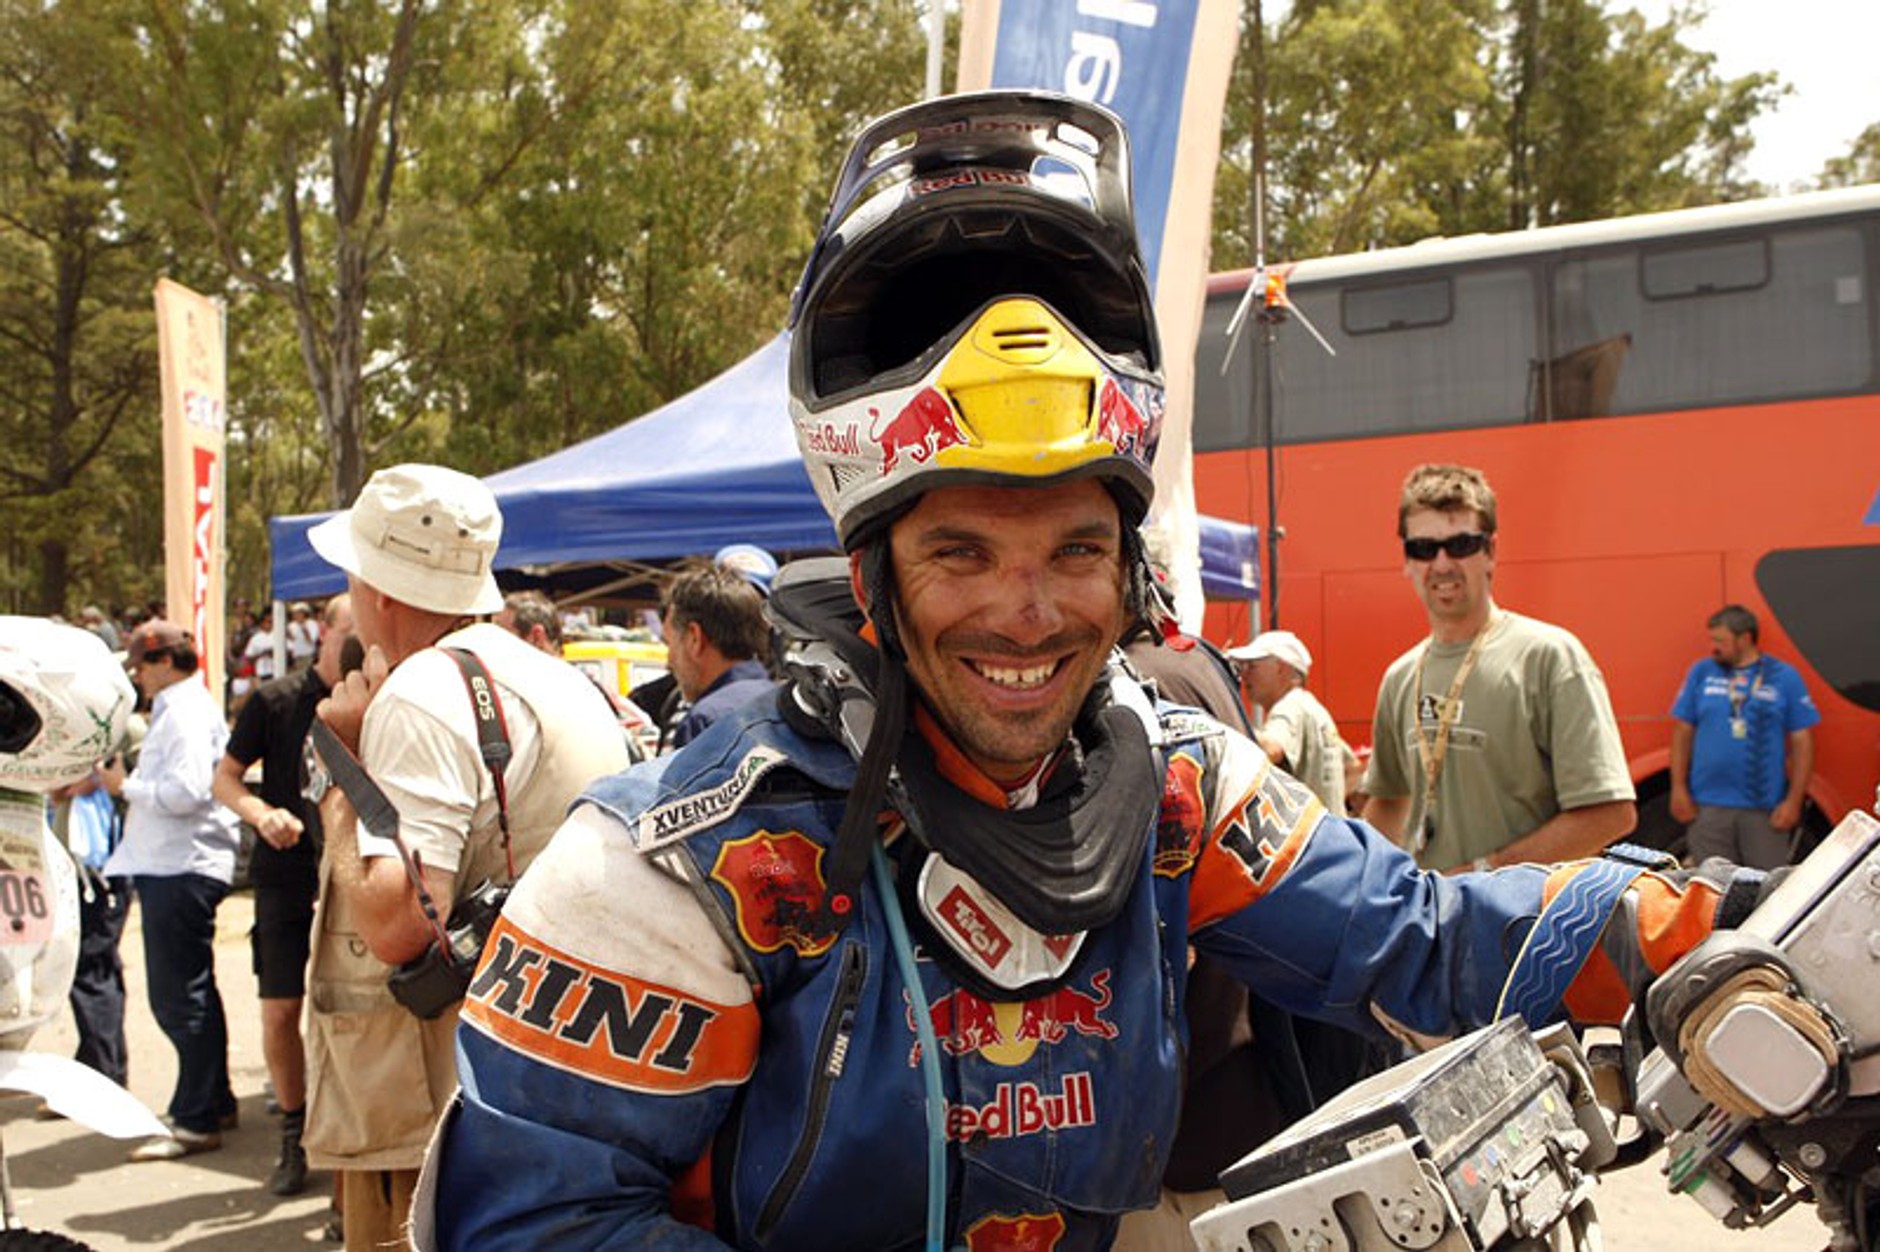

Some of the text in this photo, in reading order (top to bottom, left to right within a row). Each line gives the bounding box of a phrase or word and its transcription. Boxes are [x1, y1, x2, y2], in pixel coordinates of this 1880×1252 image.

[825, 424, 860, 455] Bull
[472, 676, 495, 720] EOS
[467, 933, 720, 1073] KINI
[926, 1071, 1095, 1142] ed Bull
